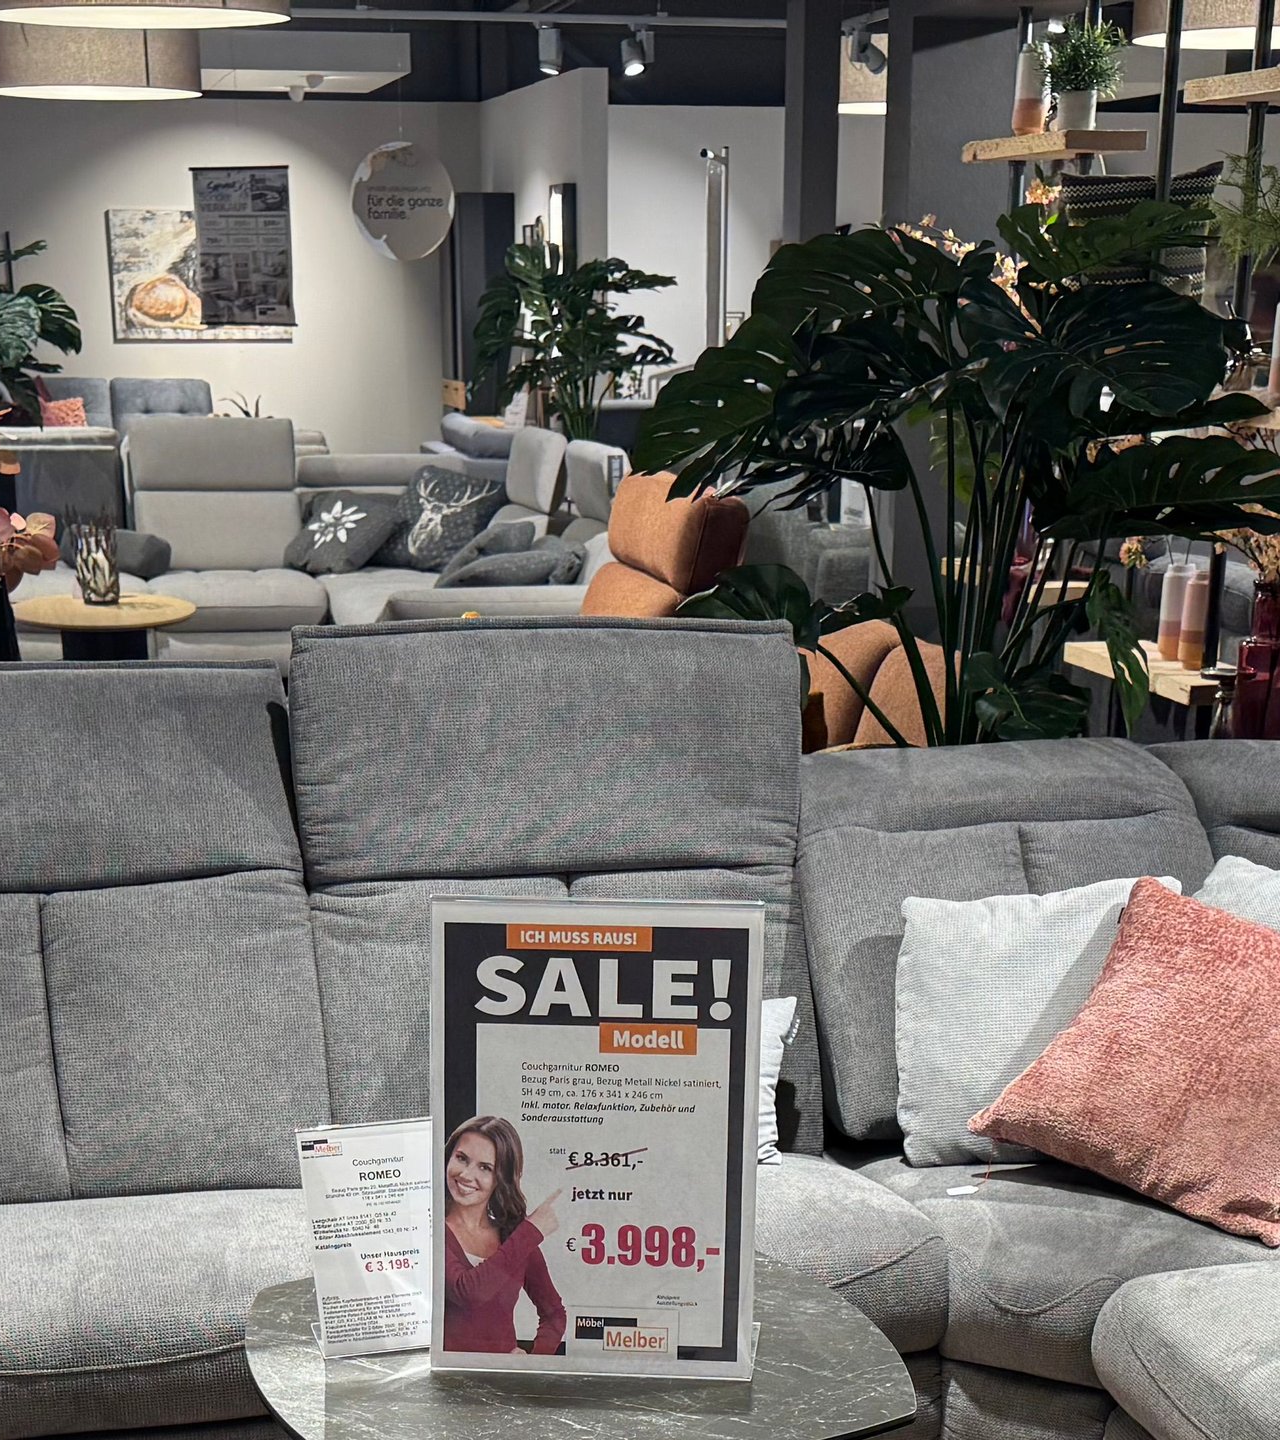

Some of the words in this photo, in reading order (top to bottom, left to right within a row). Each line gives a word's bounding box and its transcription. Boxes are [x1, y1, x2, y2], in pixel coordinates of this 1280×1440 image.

[520, 930, 545, 944] ICH
[549, 931, 590, 945] MUSS
[593, 931, 638, 945] RAUS!
[474, 955, 732, 1021] SALE!
[612, 1029, 685, 1050] Modell
[521, 1061, 583, 1072] Couchgarnitur
[585, 1063, 620, 1073] ROMEO
[521, 1075, 547, 1085] Bezug
[549, 1075, 570, 1085] Paris
[572, 1077, 594, 1087] grau,
[596, 1077, 623, 1087] Bezug
[624, 1077, 653, 1087] Metall
[655, 1078, 681, 1087] Nickel
[521, 1088, 533, 1096] SH
[535, 1088, 546, 1097] 49
[548, 1090, 564, 1098] cm,
[566, 1090, 578, 1098] ca.
[581, 1089, 597, 1098] 176
[606, 1089, 622, 1099] 341
[631, 1090, 648, 1099] 246
[521, 1100, 540, 1110] Inkl.
[573, 1102, 638, 1113] Relaxfunktion,
[639, 1103, 677, 1113] Zubehör
[678, 1104, 696, 1113] und
[521, 1113, 604, 1125] Sonderausstattung
[549, 1147, 566, 1155] statt
[568, 1151, 579, 1166] €
[583, 1151, 644, 1170] 8.361,-
[358, 1168, 402, 1182] ROMEO
[571, 1186, 605, 1202] jetzt
[608, 1190, 633, 1201] nur
[565, 1237, 577, 1252] €
[580, 1222, 721, 1273] 3.998,-
[360, 1252, 382, 1260] Unser
[364, 1260, 374, 1272] €
[376, 1258, 419, 1272] 3.198,-
[576, 1317, 605, 1328] Möbel
[605, 1330, 666, 1349] Melber
